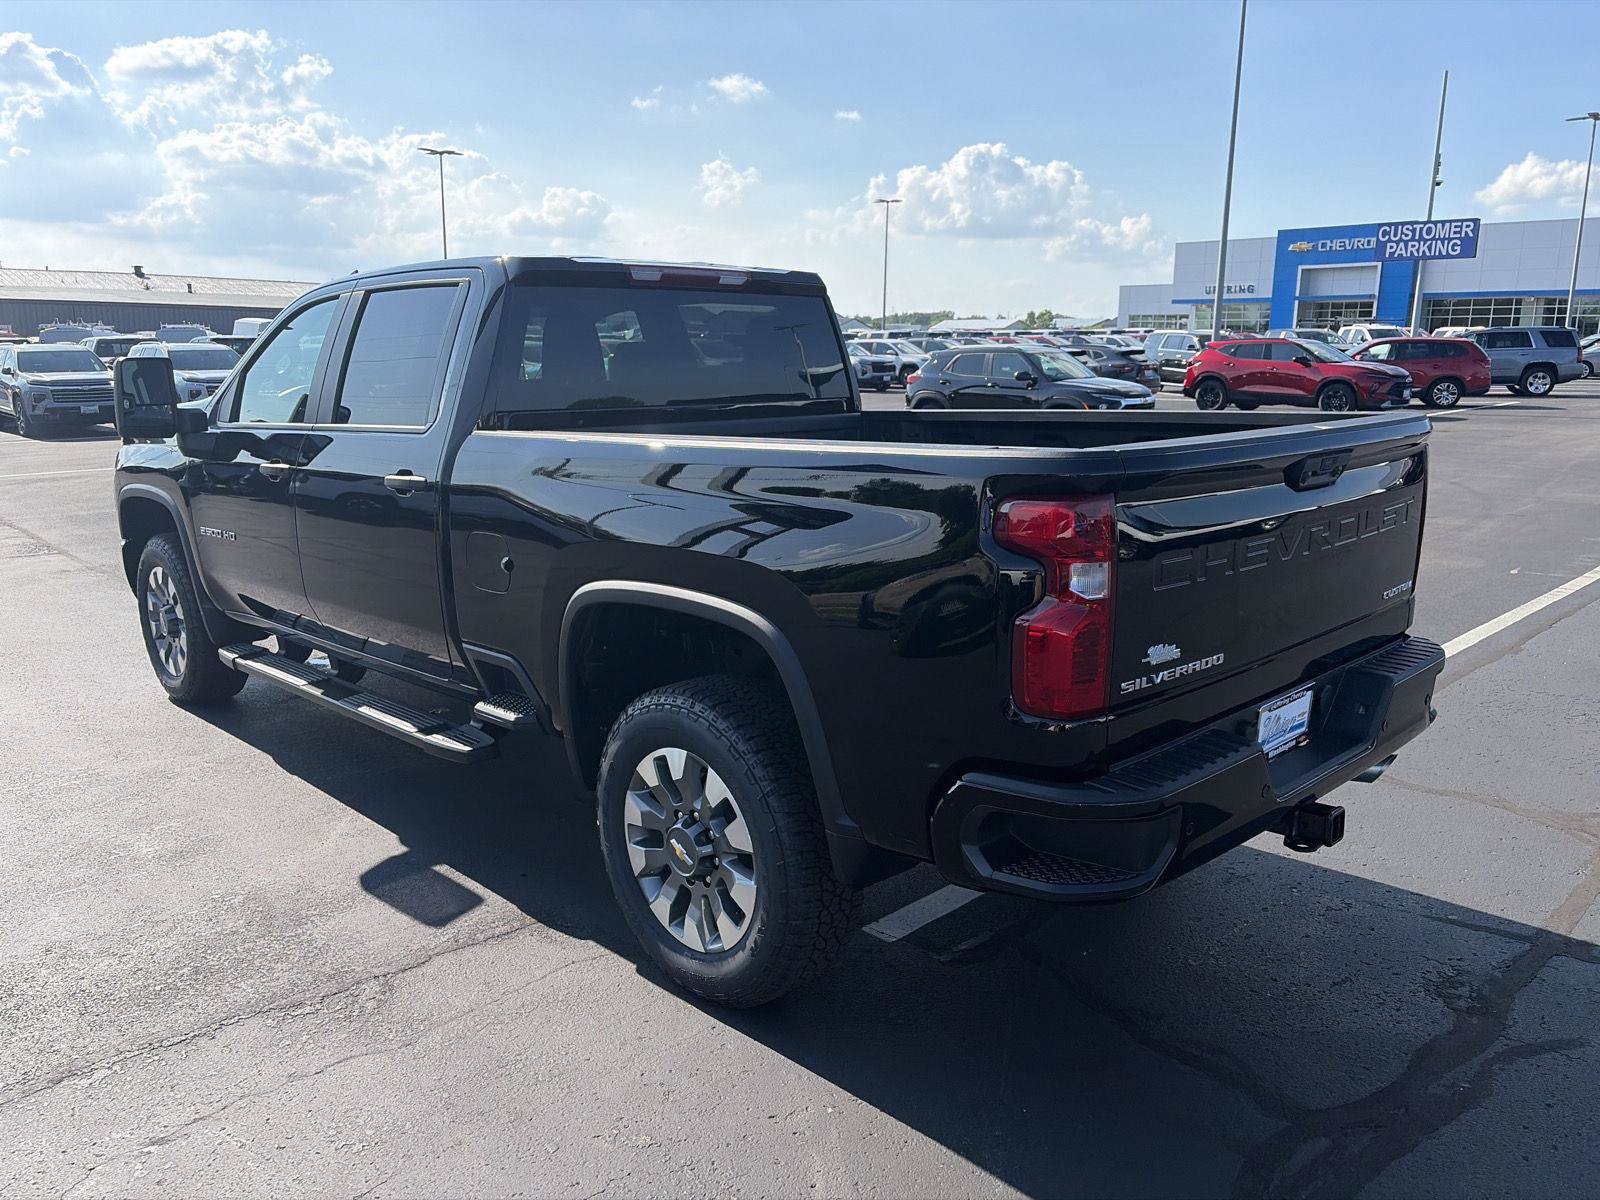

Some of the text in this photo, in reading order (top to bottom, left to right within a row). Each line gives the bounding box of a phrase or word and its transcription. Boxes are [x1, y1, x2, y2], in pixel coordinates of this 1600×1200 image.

[1378, 221, 1475, 241] CUSTOMER
[1385, 239, 1461, 258] PARKING
[200, 526, 236, 541] 2500 HD
[1153, 496, 1415, 592] CHEVROLET
[1120, 653, 1225, 694] SILVERADO
